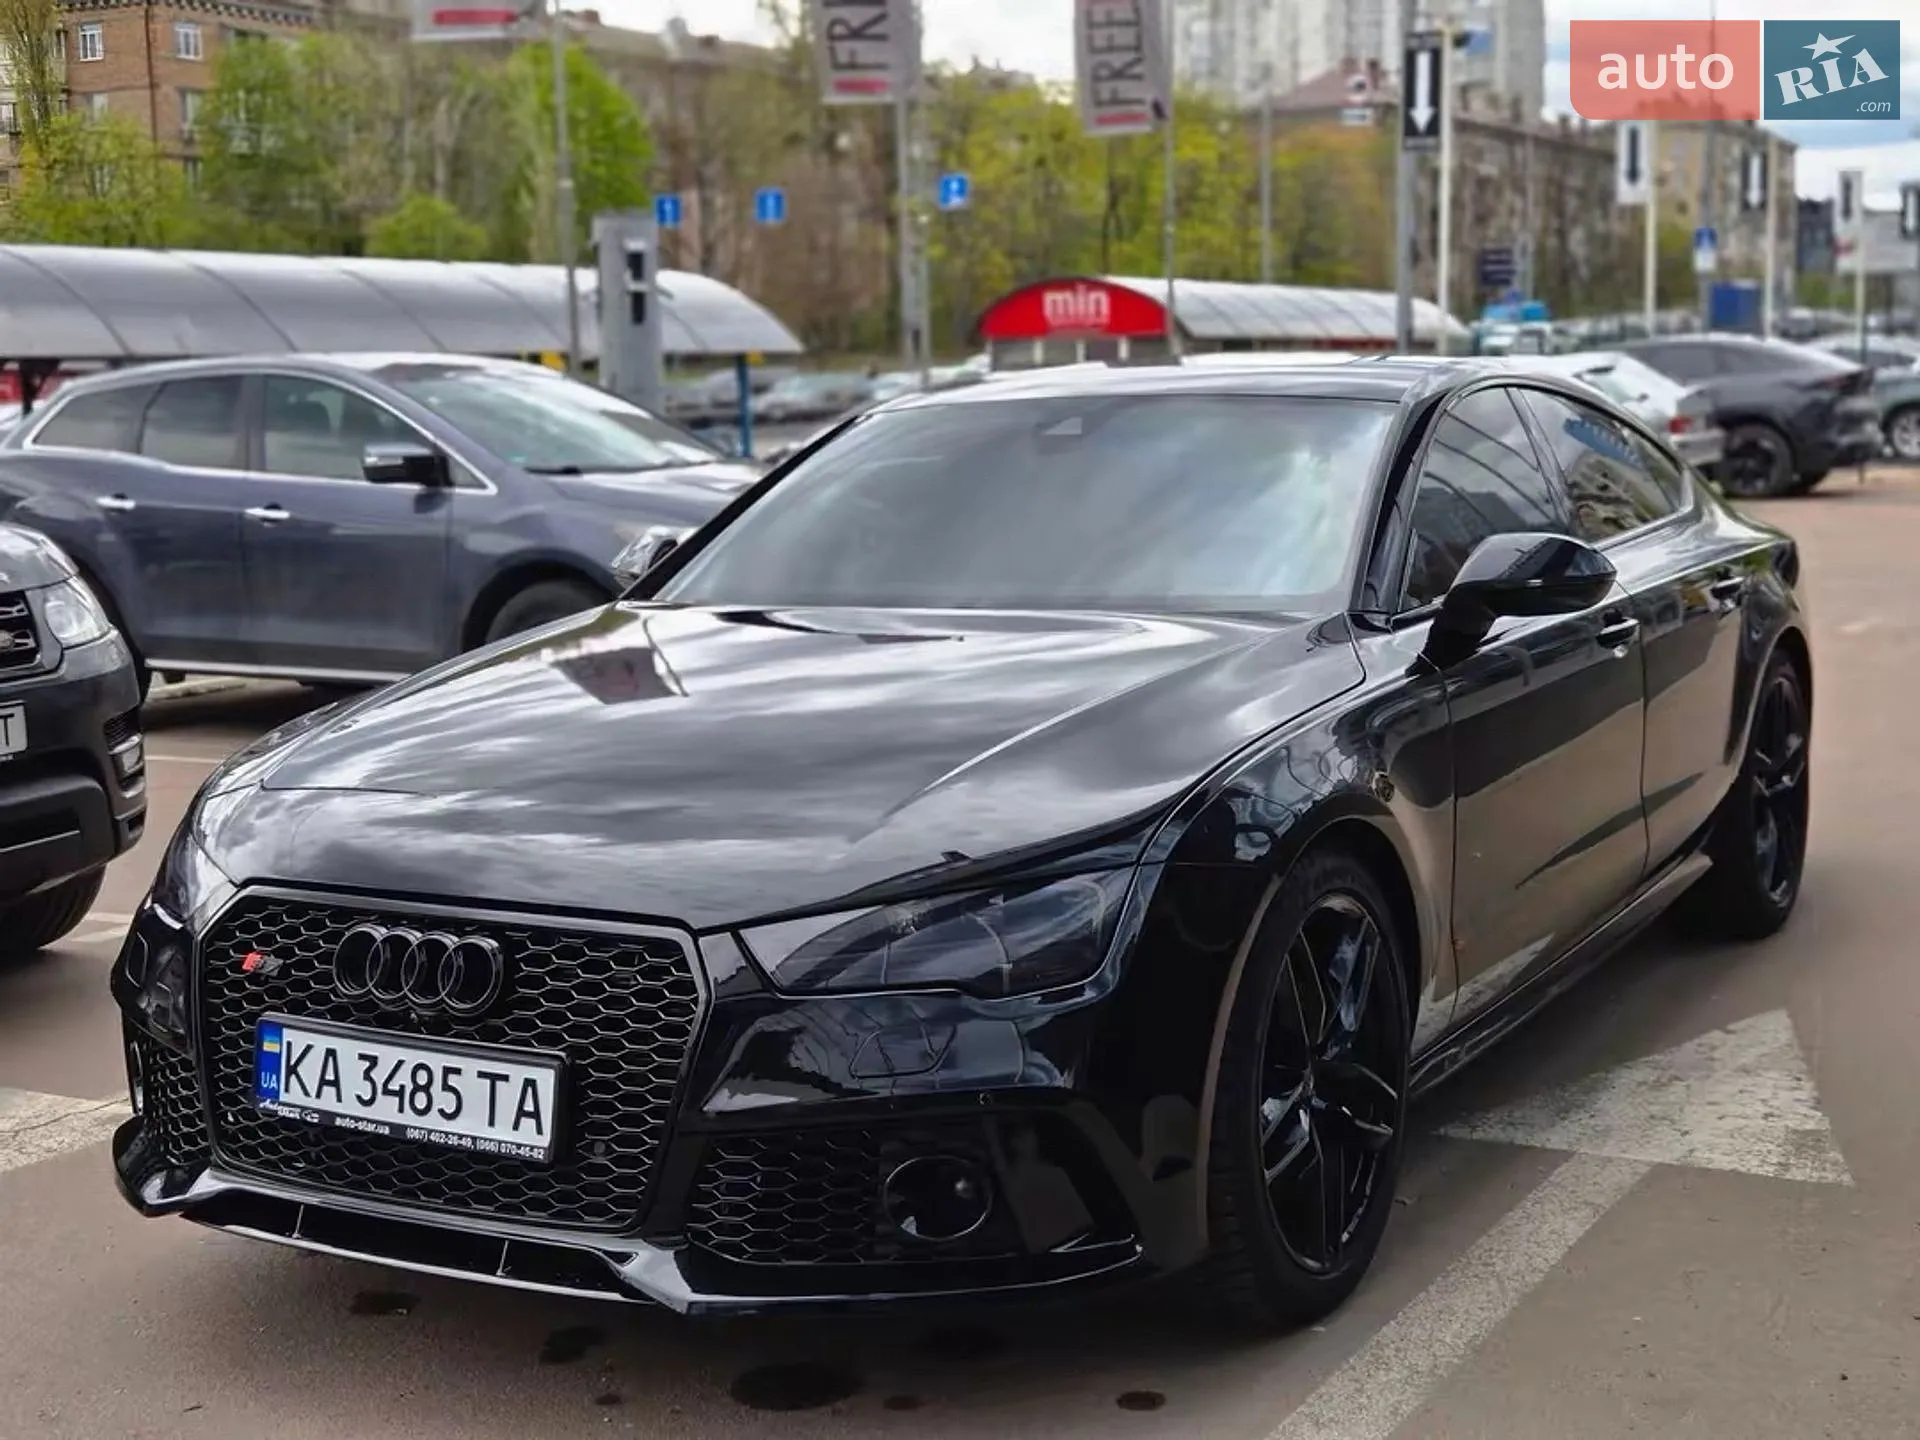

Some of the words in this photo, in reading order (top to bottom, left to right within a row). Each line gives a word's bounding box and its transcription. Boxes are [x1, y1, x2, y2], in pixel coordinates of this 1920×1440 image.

[823, 0, 889, 72] FR
[261, 1073, 279, 1090] UA
[283, 1040, 343, 1103] KA
[354, 1052, 464, 1121] 3485
[476, 1070, 545, 1136] TA
[334, 1116, 391, 1136] auto-star.ua
